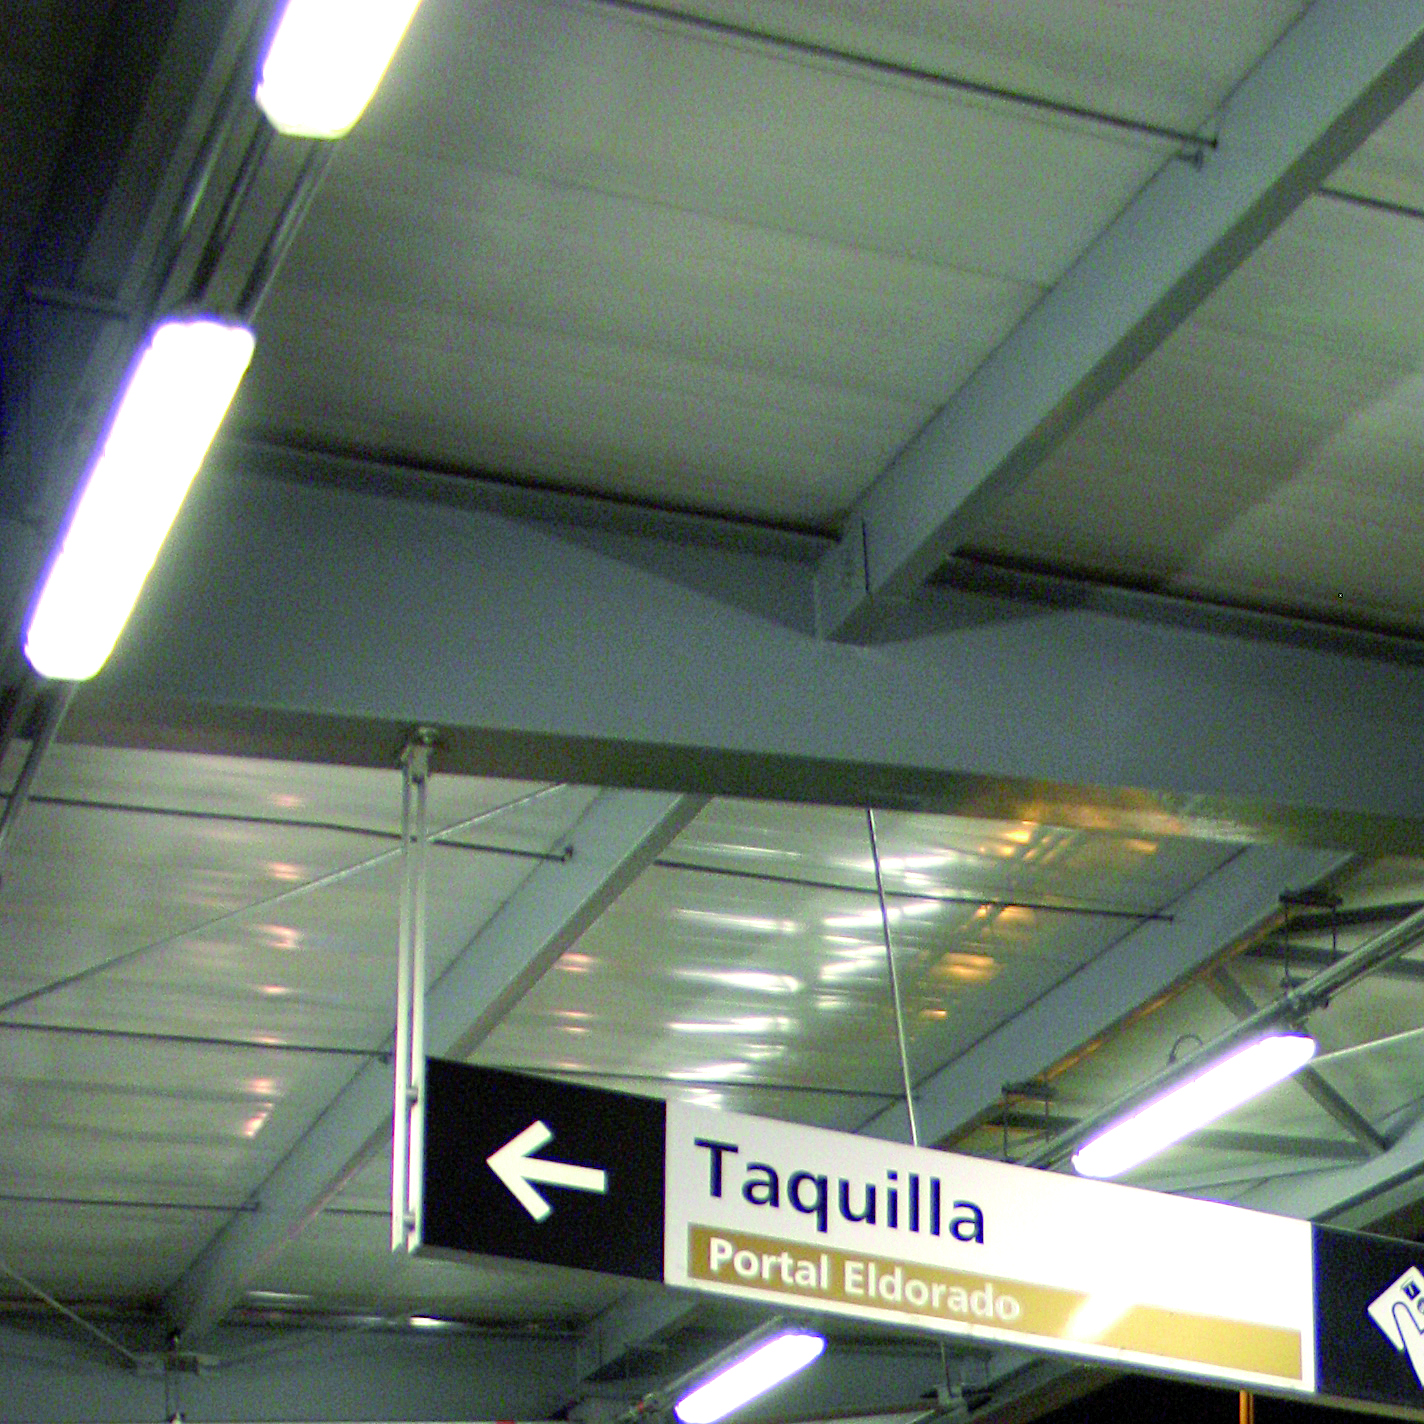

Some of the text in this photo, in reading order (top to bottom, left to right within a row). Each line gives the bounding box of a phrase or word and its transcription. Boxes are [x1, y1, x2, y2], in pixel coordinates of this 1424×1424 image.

[693, 1136, 985, 1245] Taquilla
[708, 1236, 1022, 1321] Portal Eldorado
